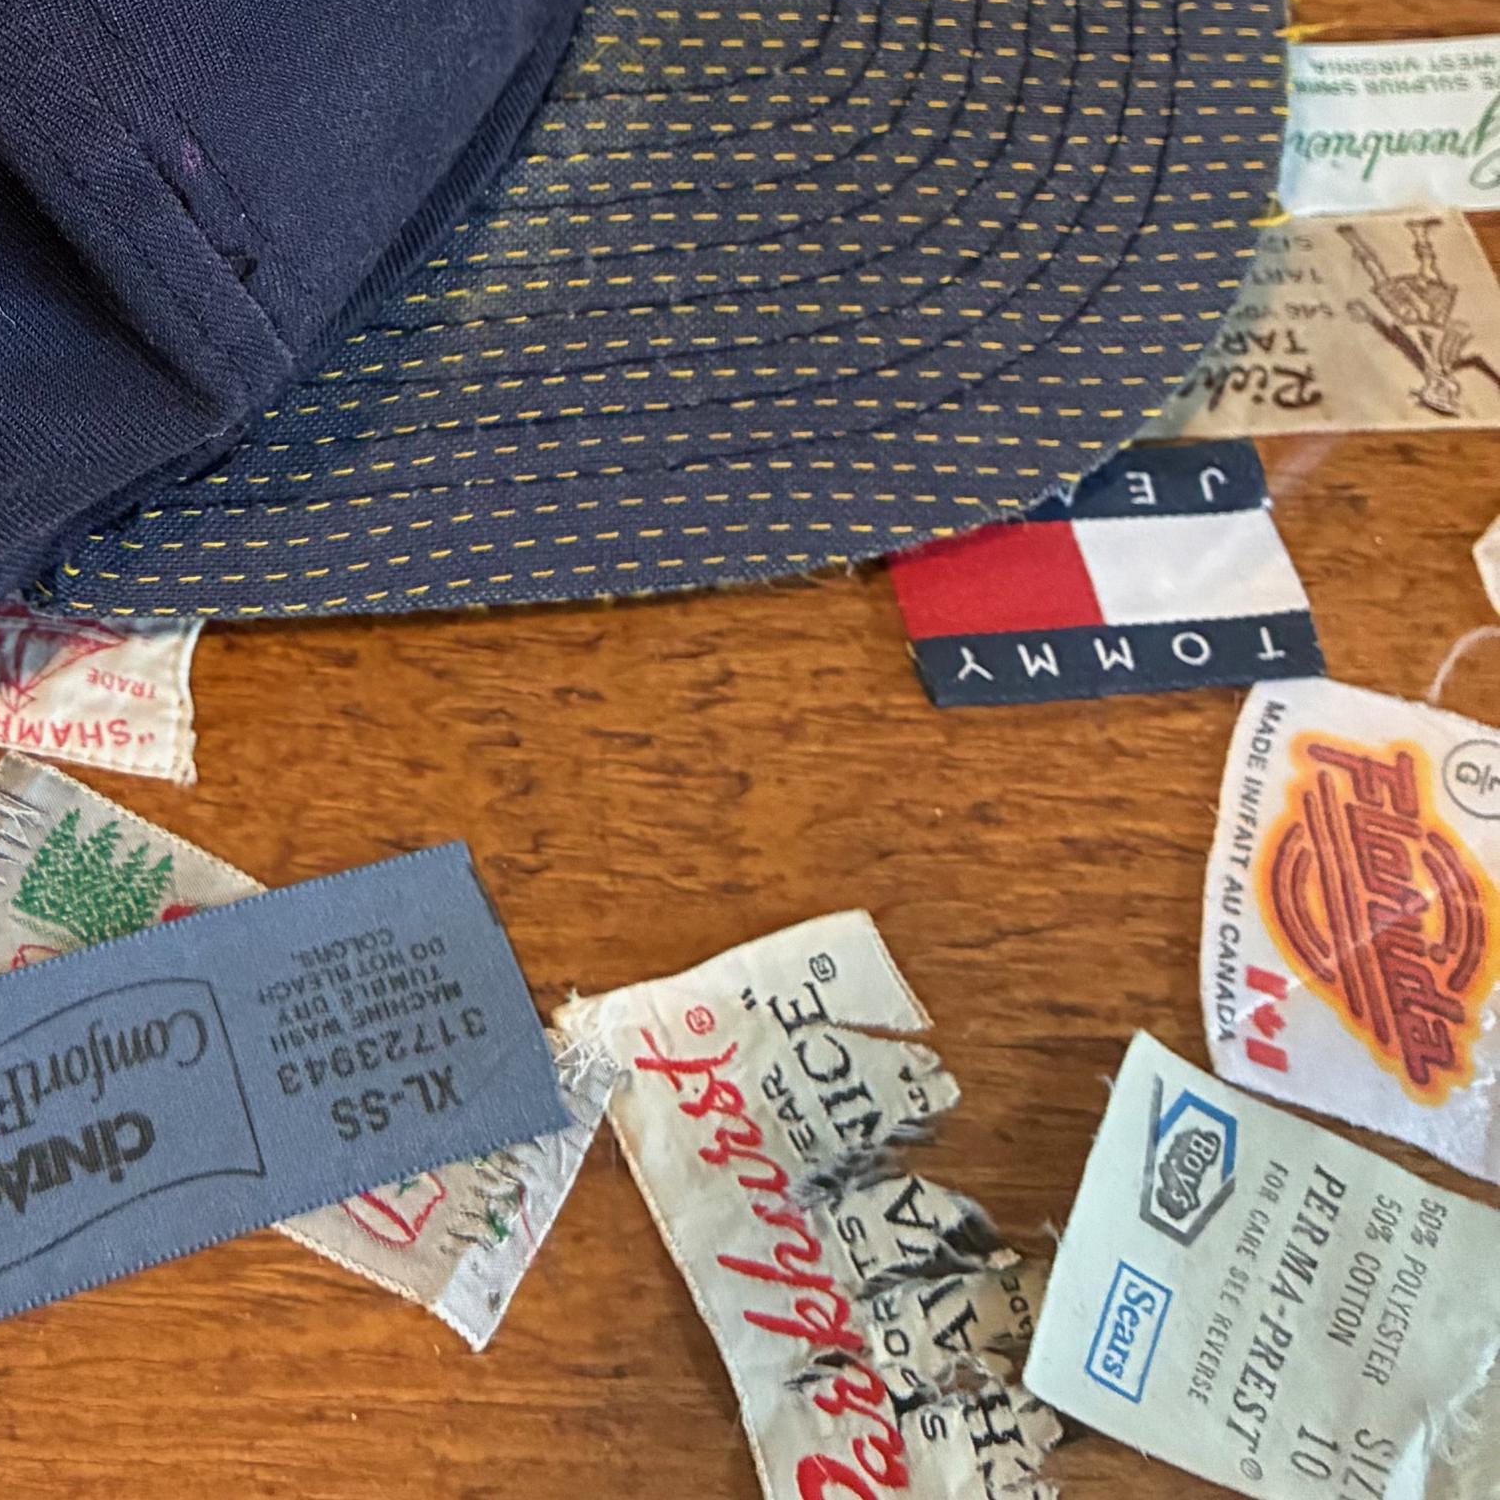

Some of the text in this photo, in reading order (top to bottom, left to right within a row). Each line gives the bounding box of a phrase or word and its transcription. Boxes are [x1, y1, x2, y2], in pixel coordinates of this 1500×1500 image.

[85, 666, 160, 702] TRADE
[955, 626, 1286, 683] TOMMY
[1246, 698, 1287, 772] MADE
[1218, 874, 1249, 916] AU
[1308, 742, 1464, 1084] Florida
[254, 933, 447, 1011] DO NOT BLEACH
[274, 956, 445, 1029] TUMBLE DRY
[1214, 921, 1242, 1043] CANADA
[267, 974, 465, 1057] MACHINE WASH
[277, 1006, 486, 1097] 31723943
[332, 1065, 458, 1140] XL-SS
[1185, 1158, 1291, 1406] FOR CARE SEE REVERSE
[1325, 1192, 1406, 1349] 50% COTTON
[1358, 1196, 1450, 1389] 50% POLYESTER
[1097, 1279, 1159, 1383] Sears
[1285, 1424, 1343, 1484] 10
[1333, 1425, 1402, 1500] SIZ
